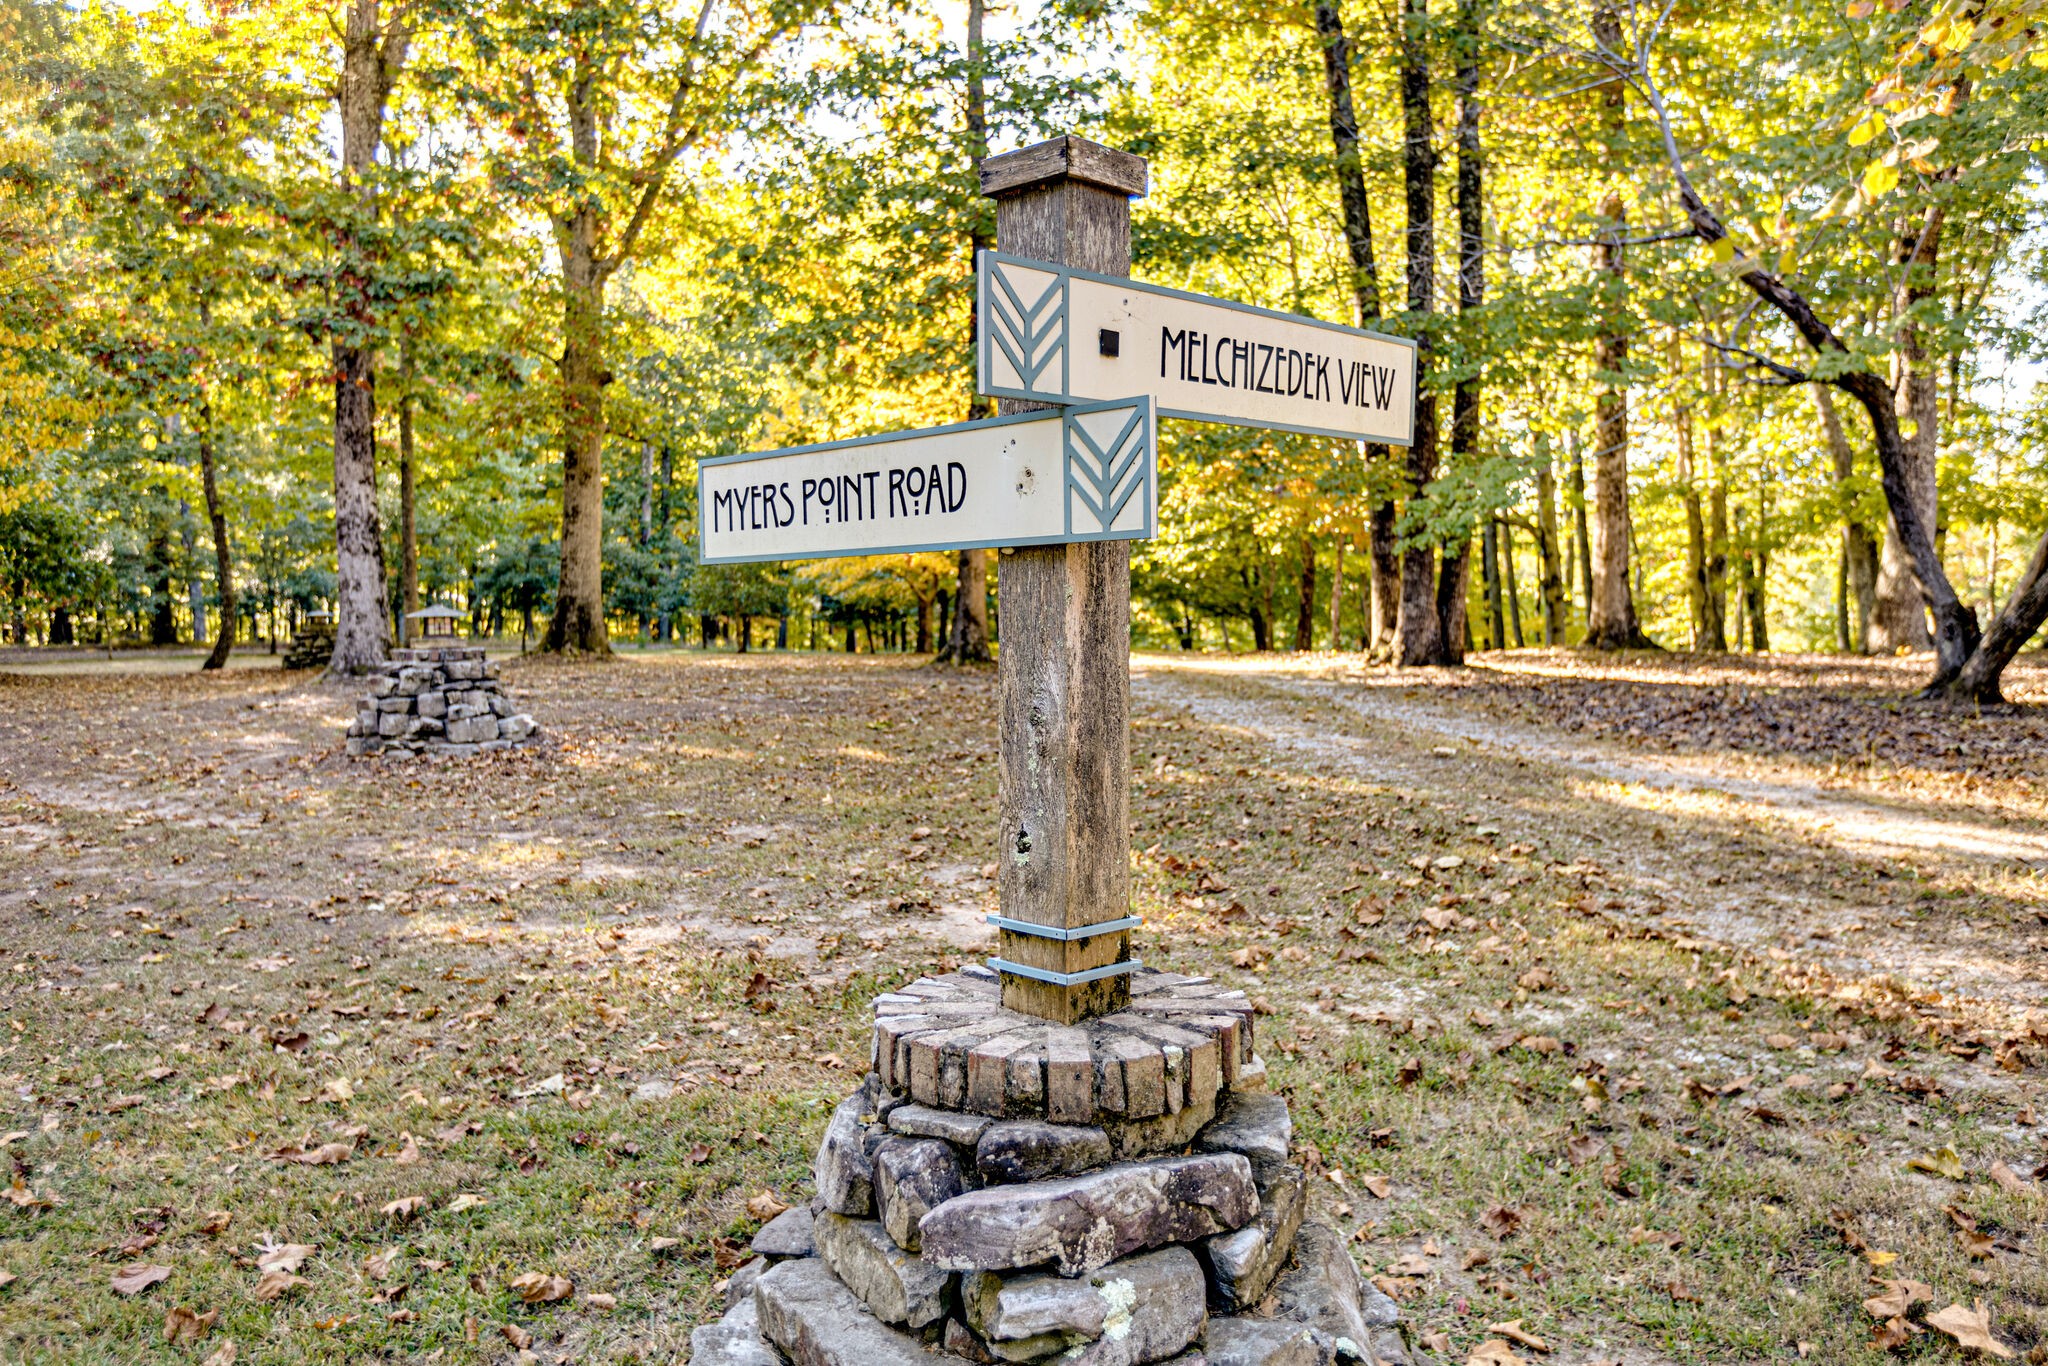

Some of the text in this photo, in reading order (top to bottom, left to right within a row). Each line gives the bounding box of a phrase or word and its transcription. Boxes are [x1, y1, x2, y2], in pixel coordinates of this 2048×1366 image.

[1160, 325, 1396, 411] MELCHIZEDEK VIEW
[713, 461, 967, 533] MYERS POINT ROAD
